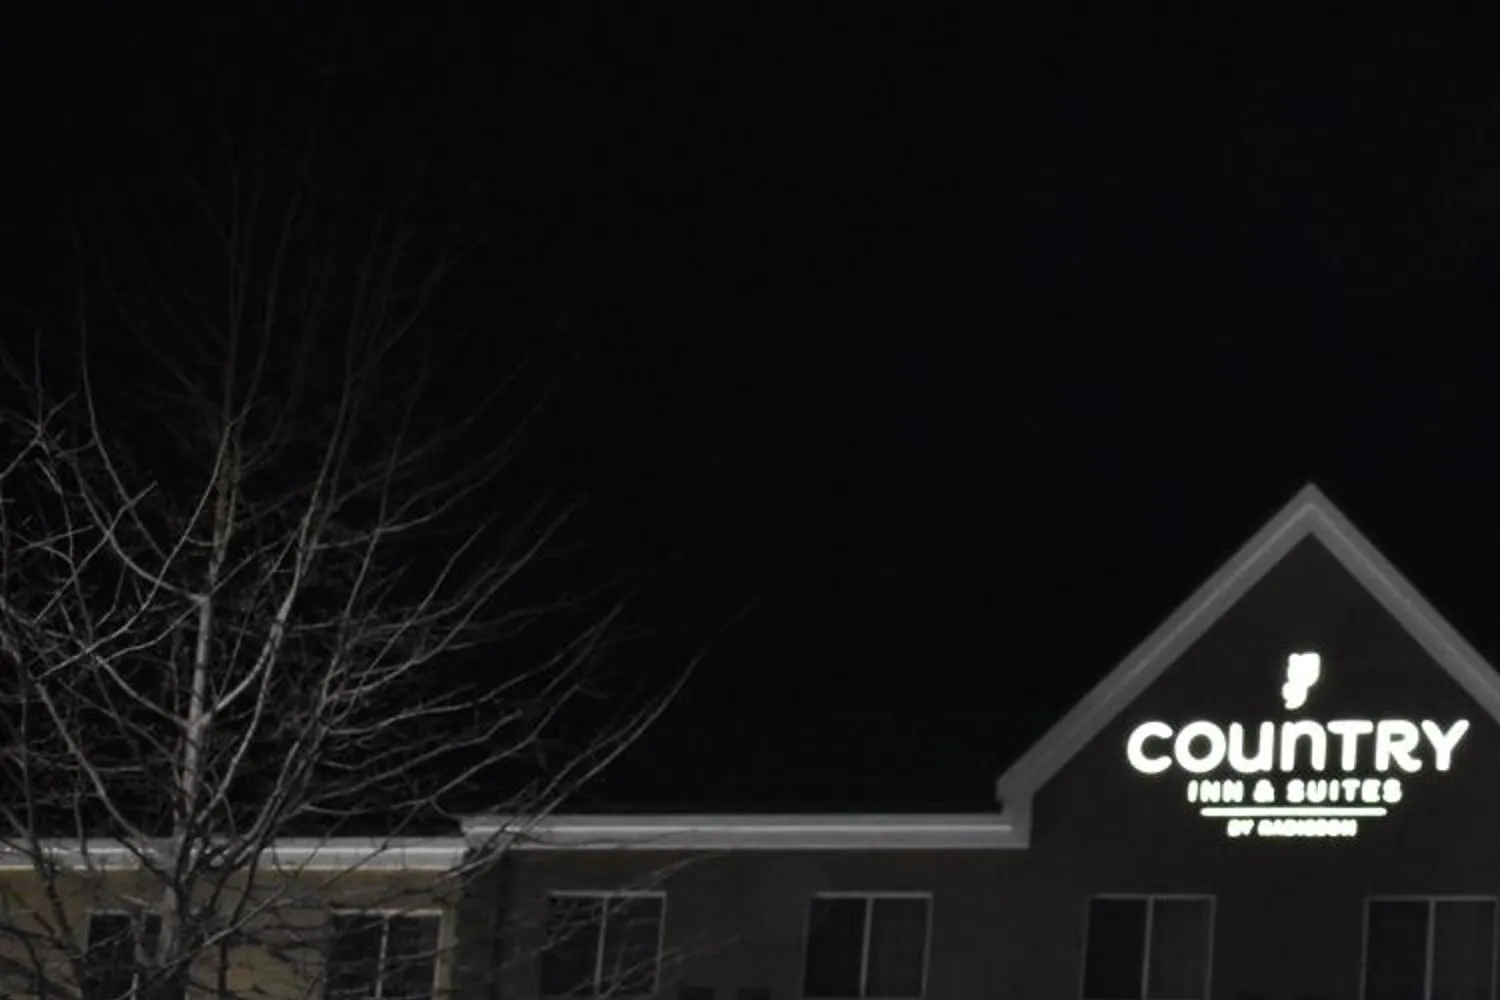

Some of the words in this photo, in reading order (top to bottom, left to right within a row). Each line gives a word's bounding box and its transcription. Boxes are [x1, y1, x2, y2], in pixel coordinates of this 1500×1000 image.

[1127, 719, 1470, 774] COUNTRY
[1187, 779, 1244, 803] INN
[1286, 778, 1402, 803] SUITES
